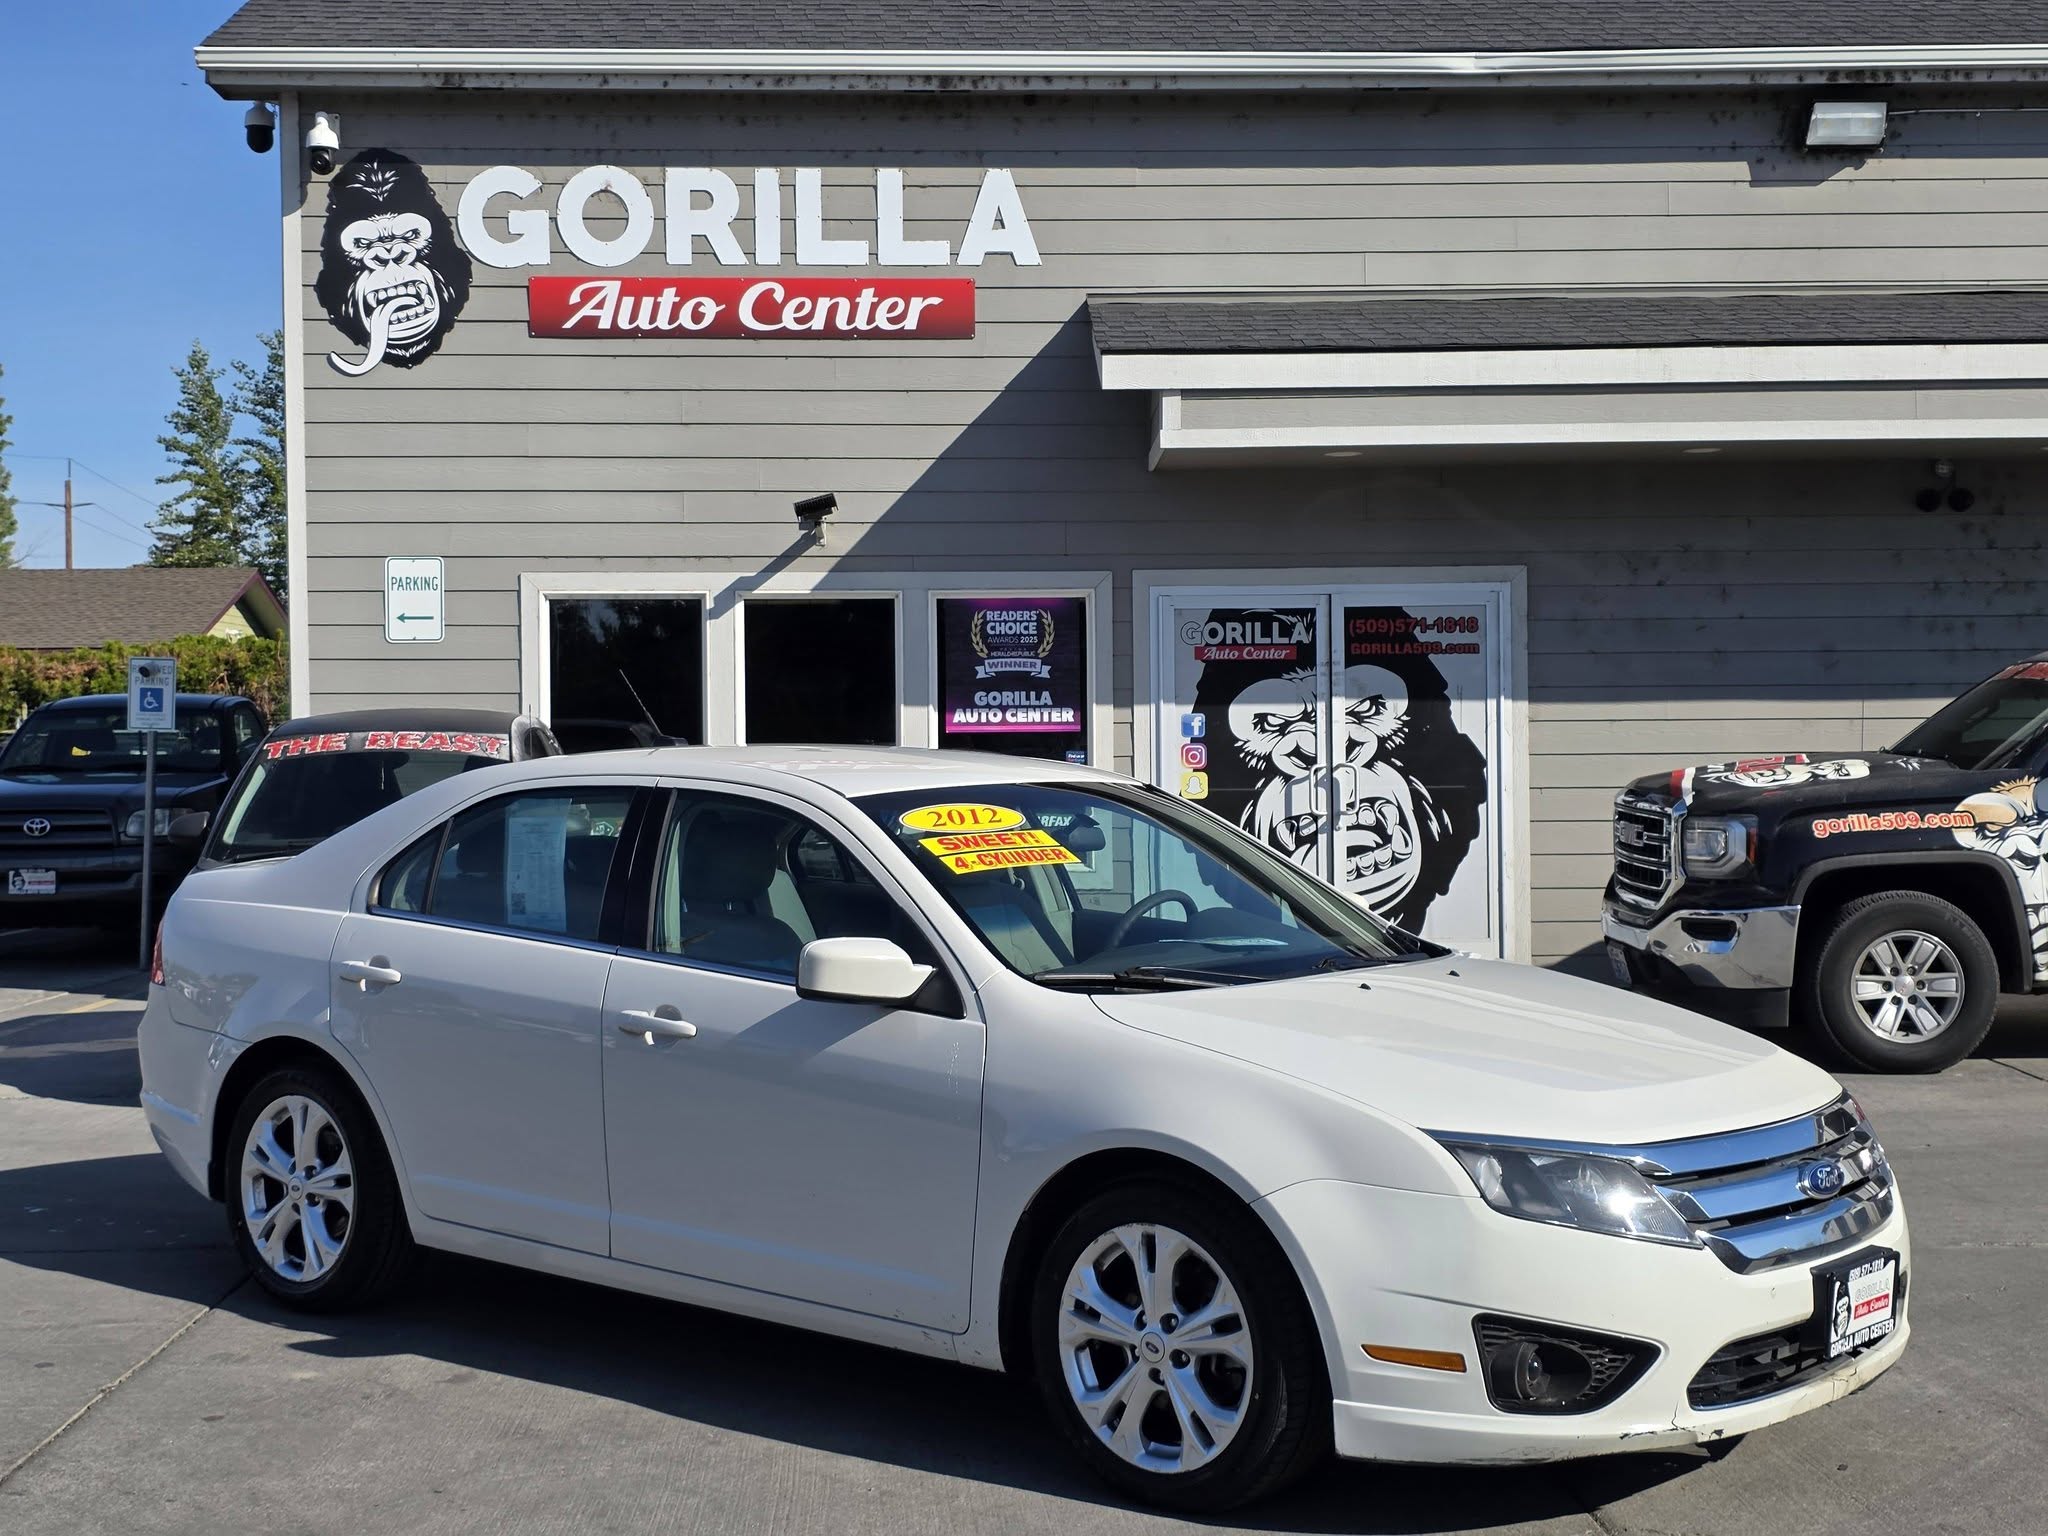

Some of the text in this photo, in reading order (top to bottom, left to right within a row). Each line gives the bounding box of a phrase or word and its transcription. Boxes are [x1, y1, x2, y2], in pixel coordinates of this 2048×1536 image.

[457, 165, 1043, 267] GORILLA
[562, 281, 944, 332] Auto Center
[390, 575, 439, 592] PARKING
[986, 610, 1039, 621] READERS'
[986, 622, 1038, 635] CHOICE
[1180, 620, 1313, 646] GORILLA
[1349, 616, 1480, 637] (509)571-1818
[1203, 646, 1290, 660] Auto Center
[1350, 641, 1480, 655] GORILLA509.com
[988, 660, 1038, 670] WINNER
[974, 691, 1053, 706] GORILLA
[952, 707, 1075, 723] AUTO CENTER
[263, 731, 510, 760] THE BEAST
[926, 808, 1003, 828] 2012
[1812, 811, 1976, 839] gorilla509.com
[937, 832, 1042, 851] SWEET!
[954, 848, 1069, 870] 4-CYLINDER
[1818, 1167, 1841, 1189] Ford
[1854, 1327, 1870, 1347] AUTO
[1870, 1318, 1895, 1340] CENTER
